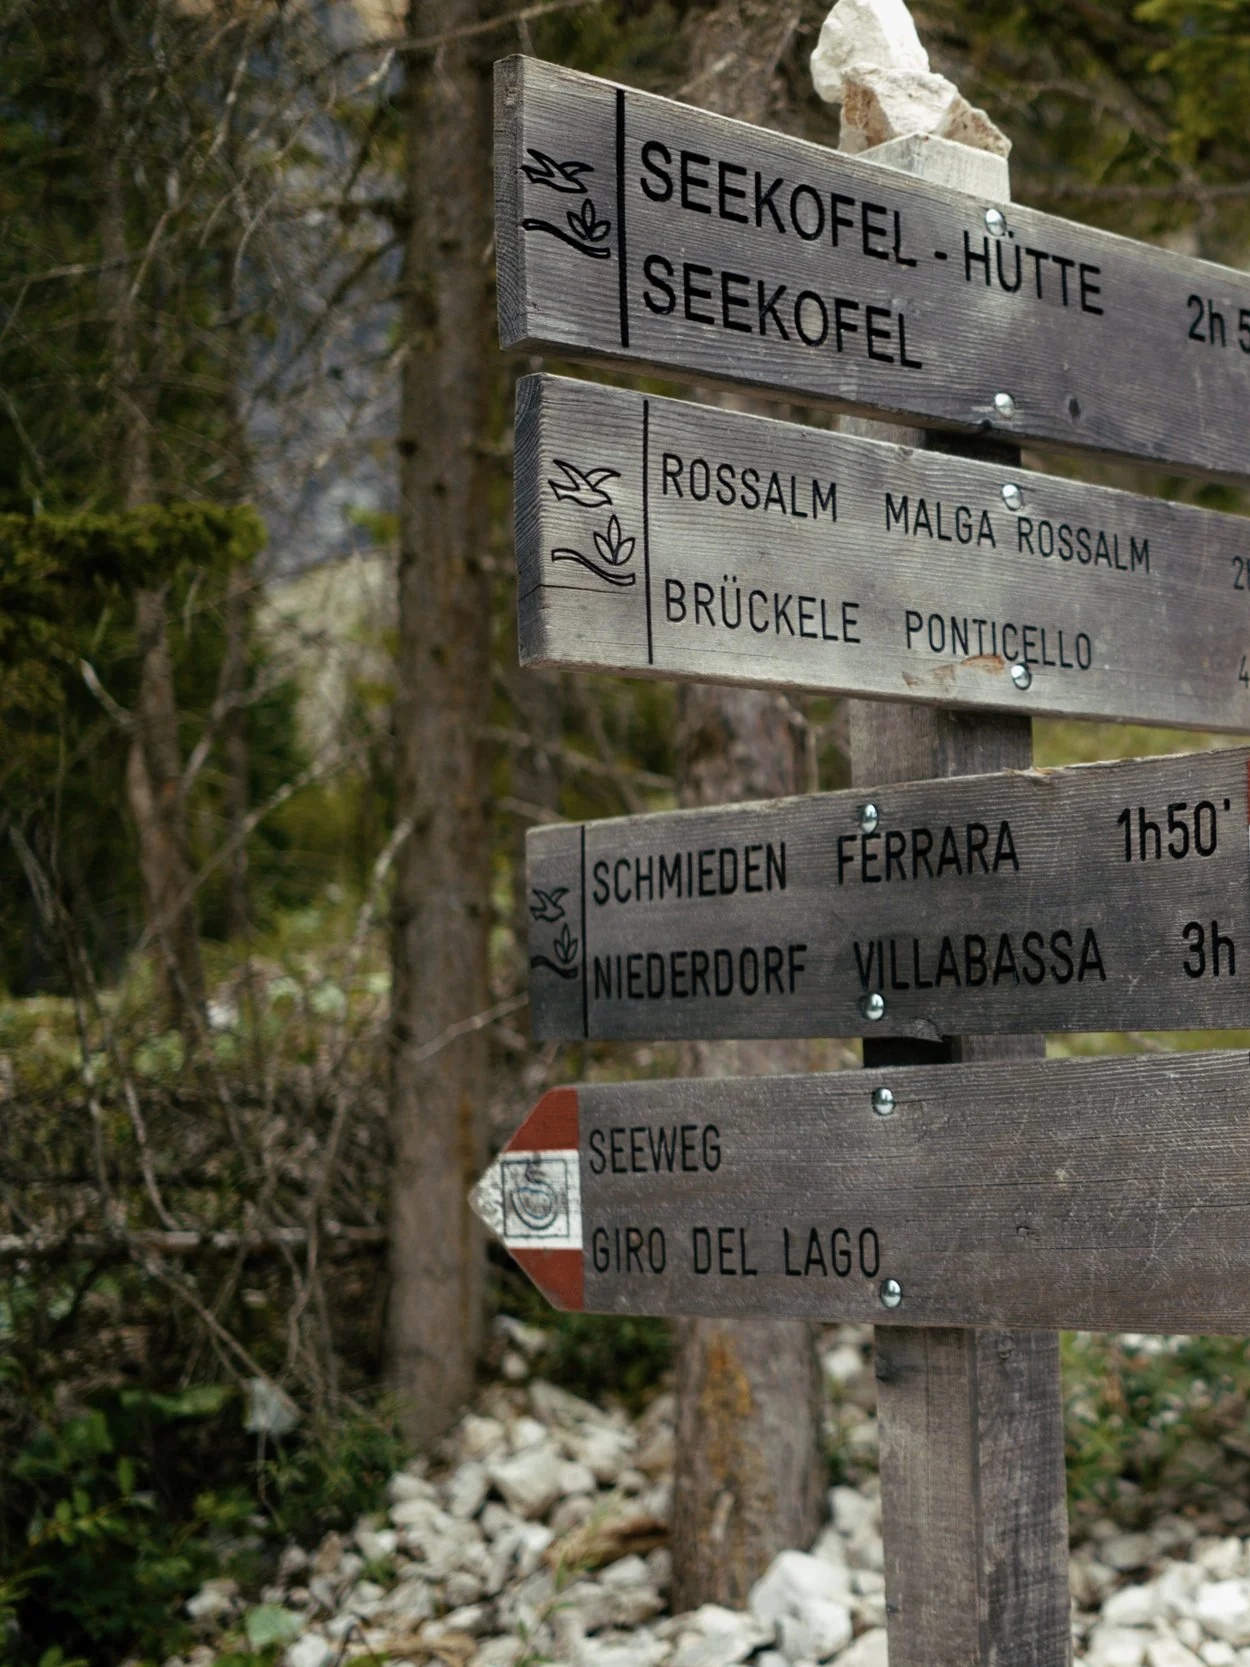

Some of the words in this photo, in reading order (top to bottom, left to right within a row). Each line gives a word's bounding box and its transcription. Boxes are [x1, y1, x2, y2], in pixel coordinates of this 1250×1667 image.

[640, 140, 918, 267] SEEKOFEL
[962, 230, 1104, 315] HÜTTE
[1187, 295, 1226, 348] 2h
[643, 254, 923, 369] SEEKOFEL
[662, 452, 838, 523] ROSSALM
[885, 492, 996, 549] MALGA
[1018, 515, 1151, 574] ROSSALM
[665, 574, 861, 644] BRÜCKELE
[905, 610, 1093, 671] PONTICELLO
[593, 842, 787, 907] SCHMIEDEN
[837, 820, 1020, 885] FERRARA
[1117, 798, 1231, 862] 1h50'
[593, 944, 808, 1000] NIEDERDORF
[853, 927, 1107, 991] VILLABASSA
[1183, 920, 1236, 979] 3h
[588, 1124, 722, 1174] SEEWEG
[592, 1226, 666, 1275] GIRO
[693, 1227, 758, 1276] DEL
[784, 1226, 881, 1278] LAGO
